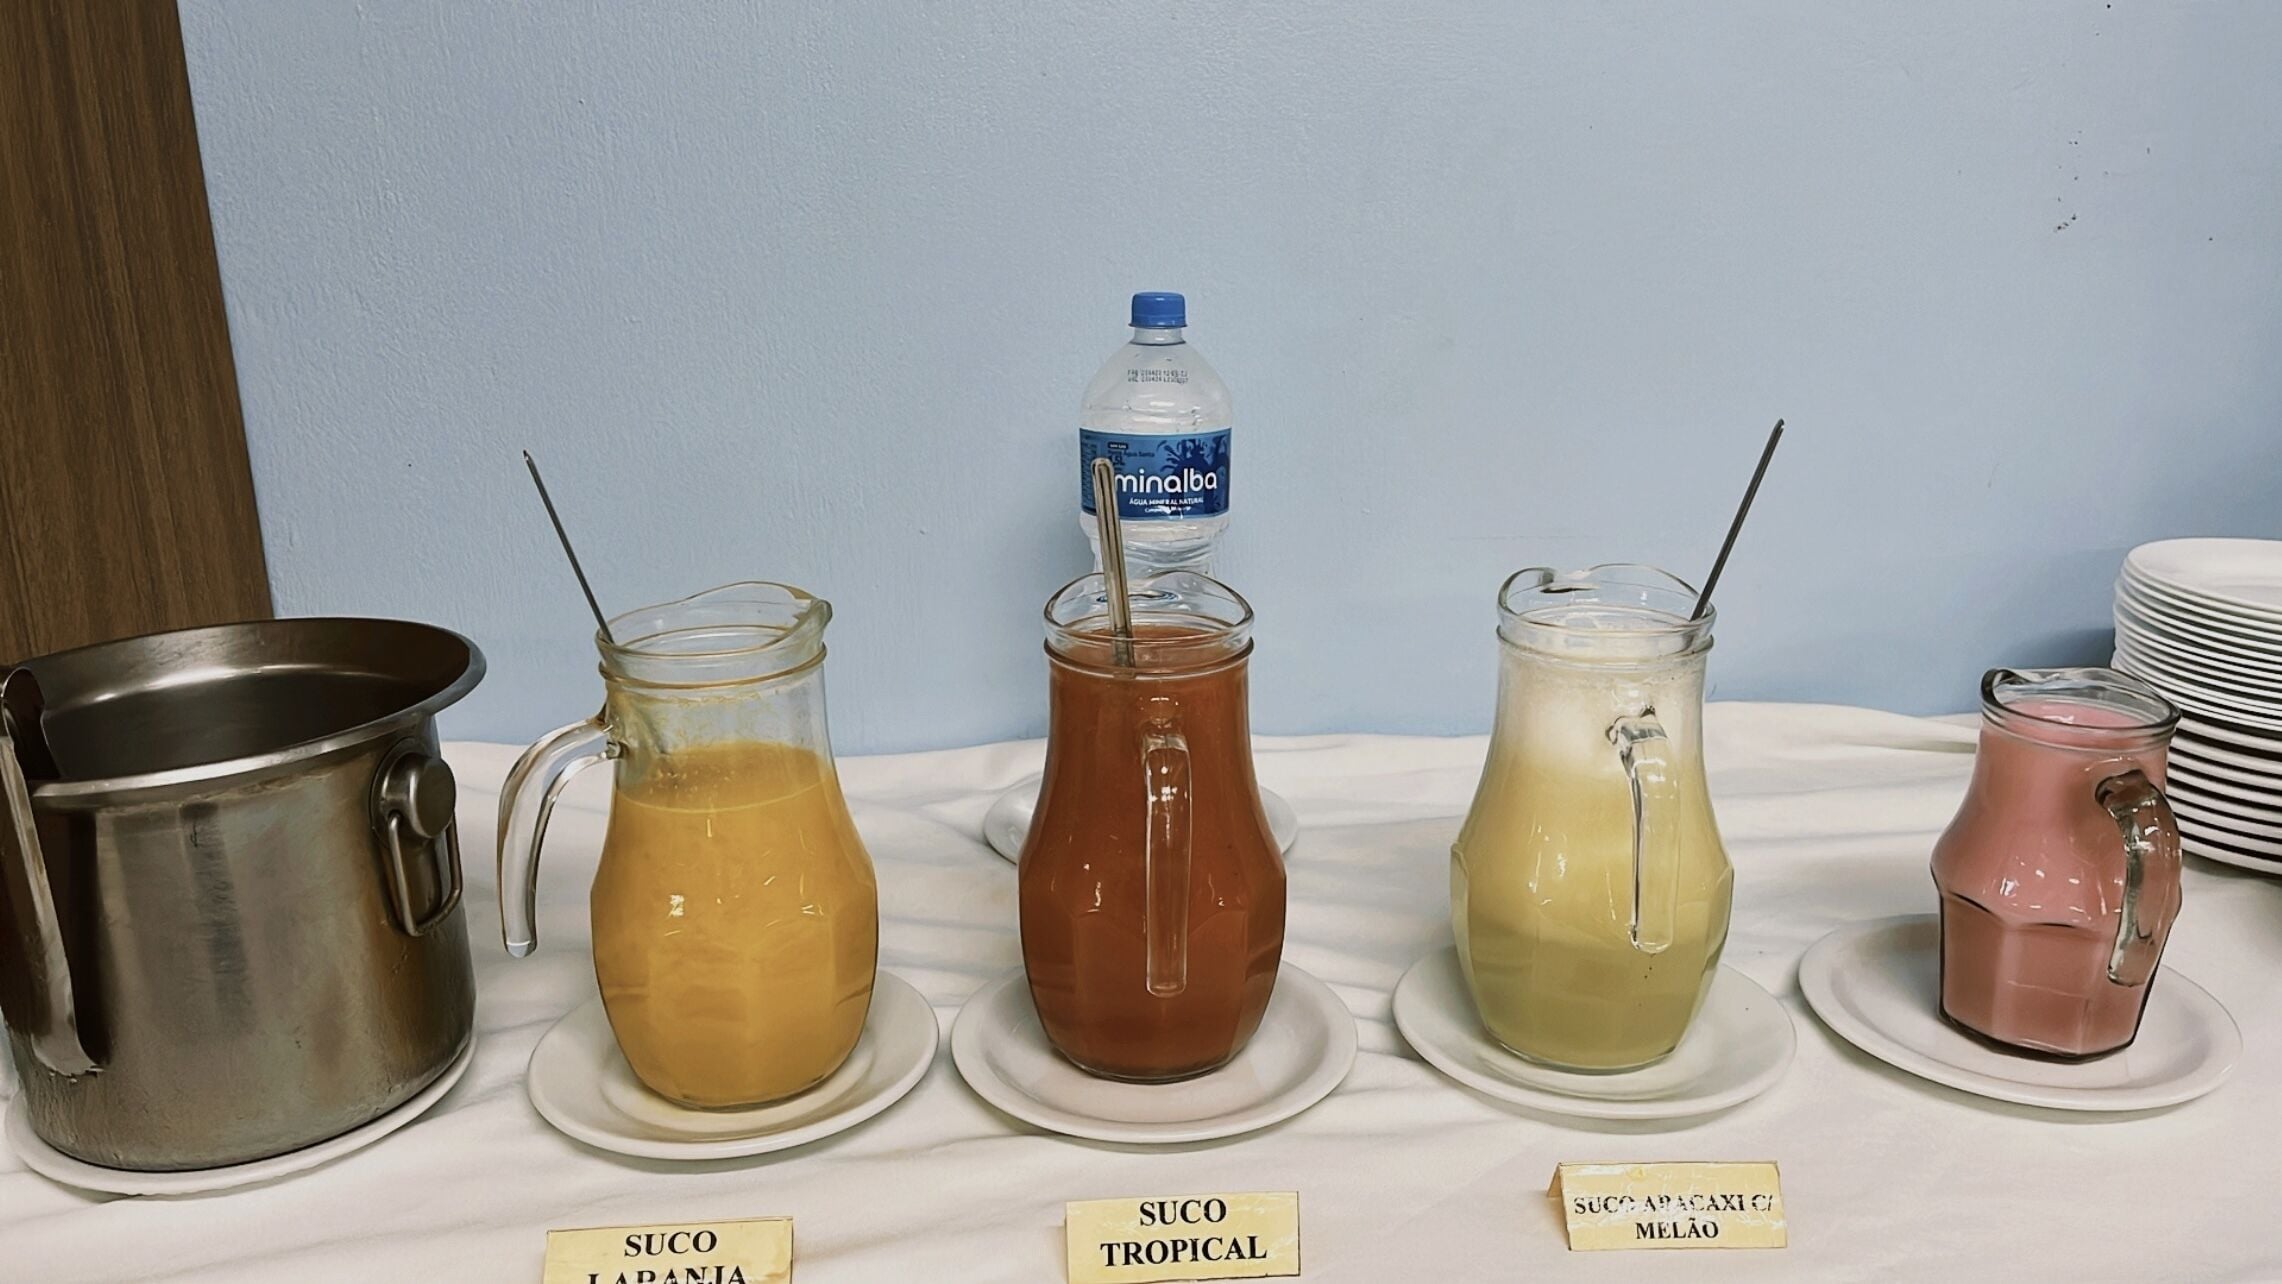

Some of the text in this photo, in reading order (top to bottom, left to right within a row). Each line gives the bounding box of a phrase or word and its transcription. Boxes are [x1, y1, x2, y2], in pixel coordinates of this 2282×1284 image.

[1115, 468, 1218, 494] minalba
[1139, 1198, 1227, 1226] SUCO
[1573, 1195, 1635, 1214] SUCO
[1635, 1216, 1719, 1239] MELÃO
[624, 1230, 718, 1257] SUCO
[1100, 1235, 1268, 1267] TROPICAL
